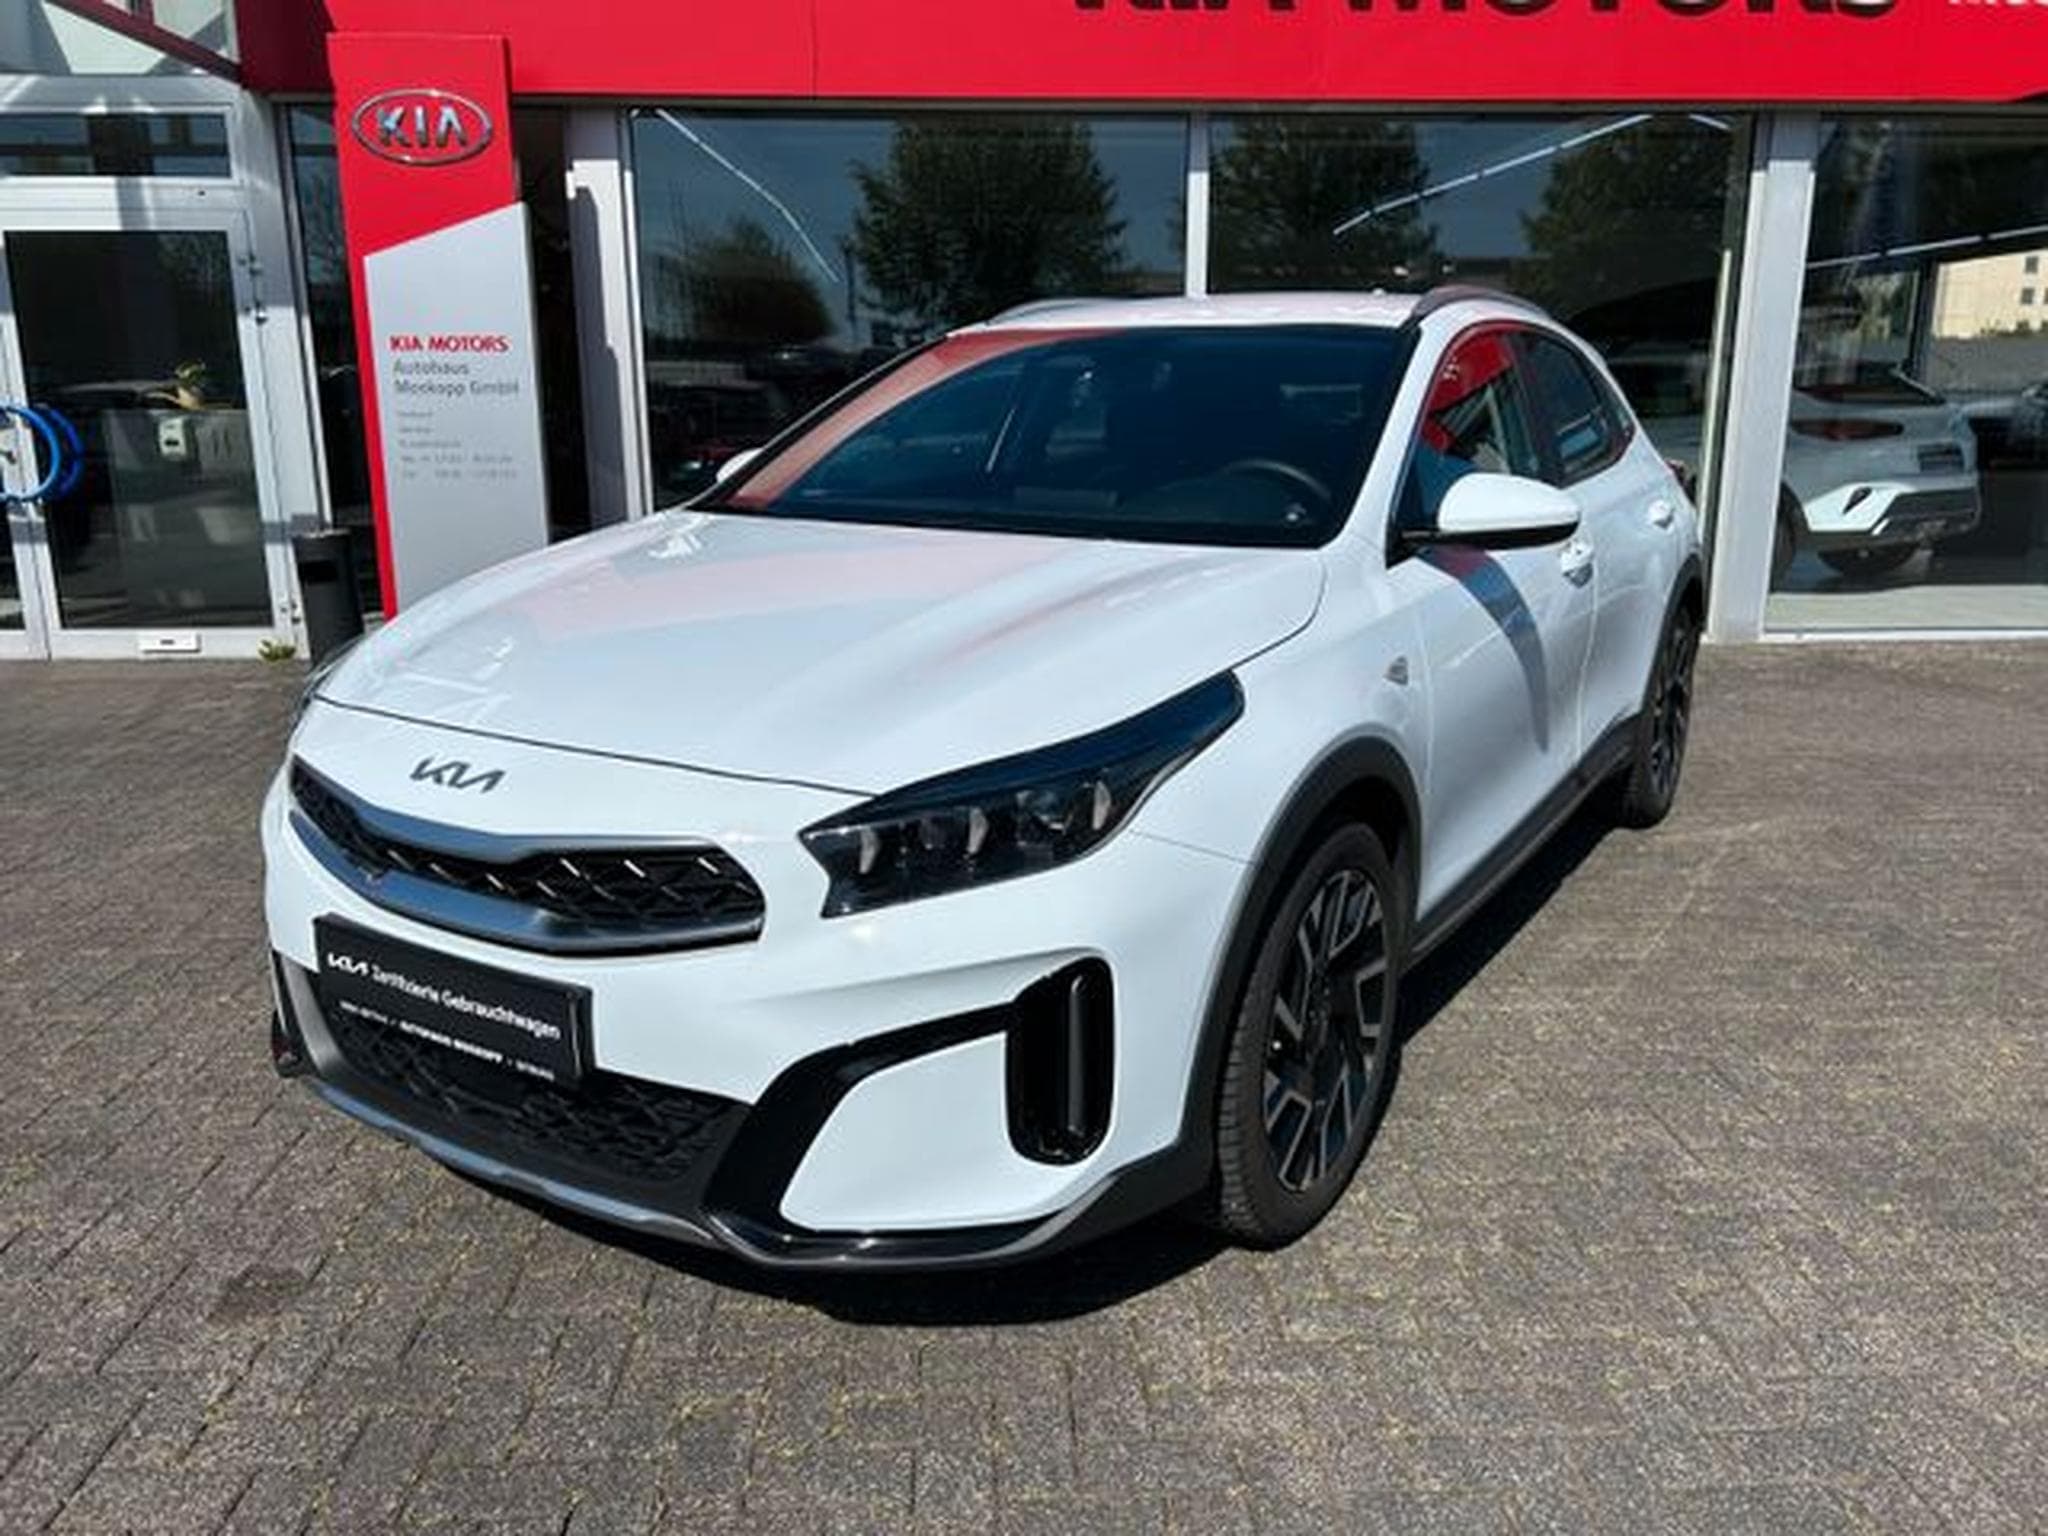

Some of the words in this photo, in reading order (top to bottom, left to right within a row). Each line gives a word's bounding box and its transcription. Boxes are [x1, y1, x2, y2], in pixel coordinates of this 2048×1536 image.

[376, 104, 468, 148] KIA
[390, 335, 423, 352] KIA
[428, 335, 509, 353] MOTORS
[393, 359, 469, 376] Autohaus
[469, 380, 519, 396] GmbH
[410, 755, 506, 793] KIA
[441, 989, 561, 1040] Gebrauchtwagen
